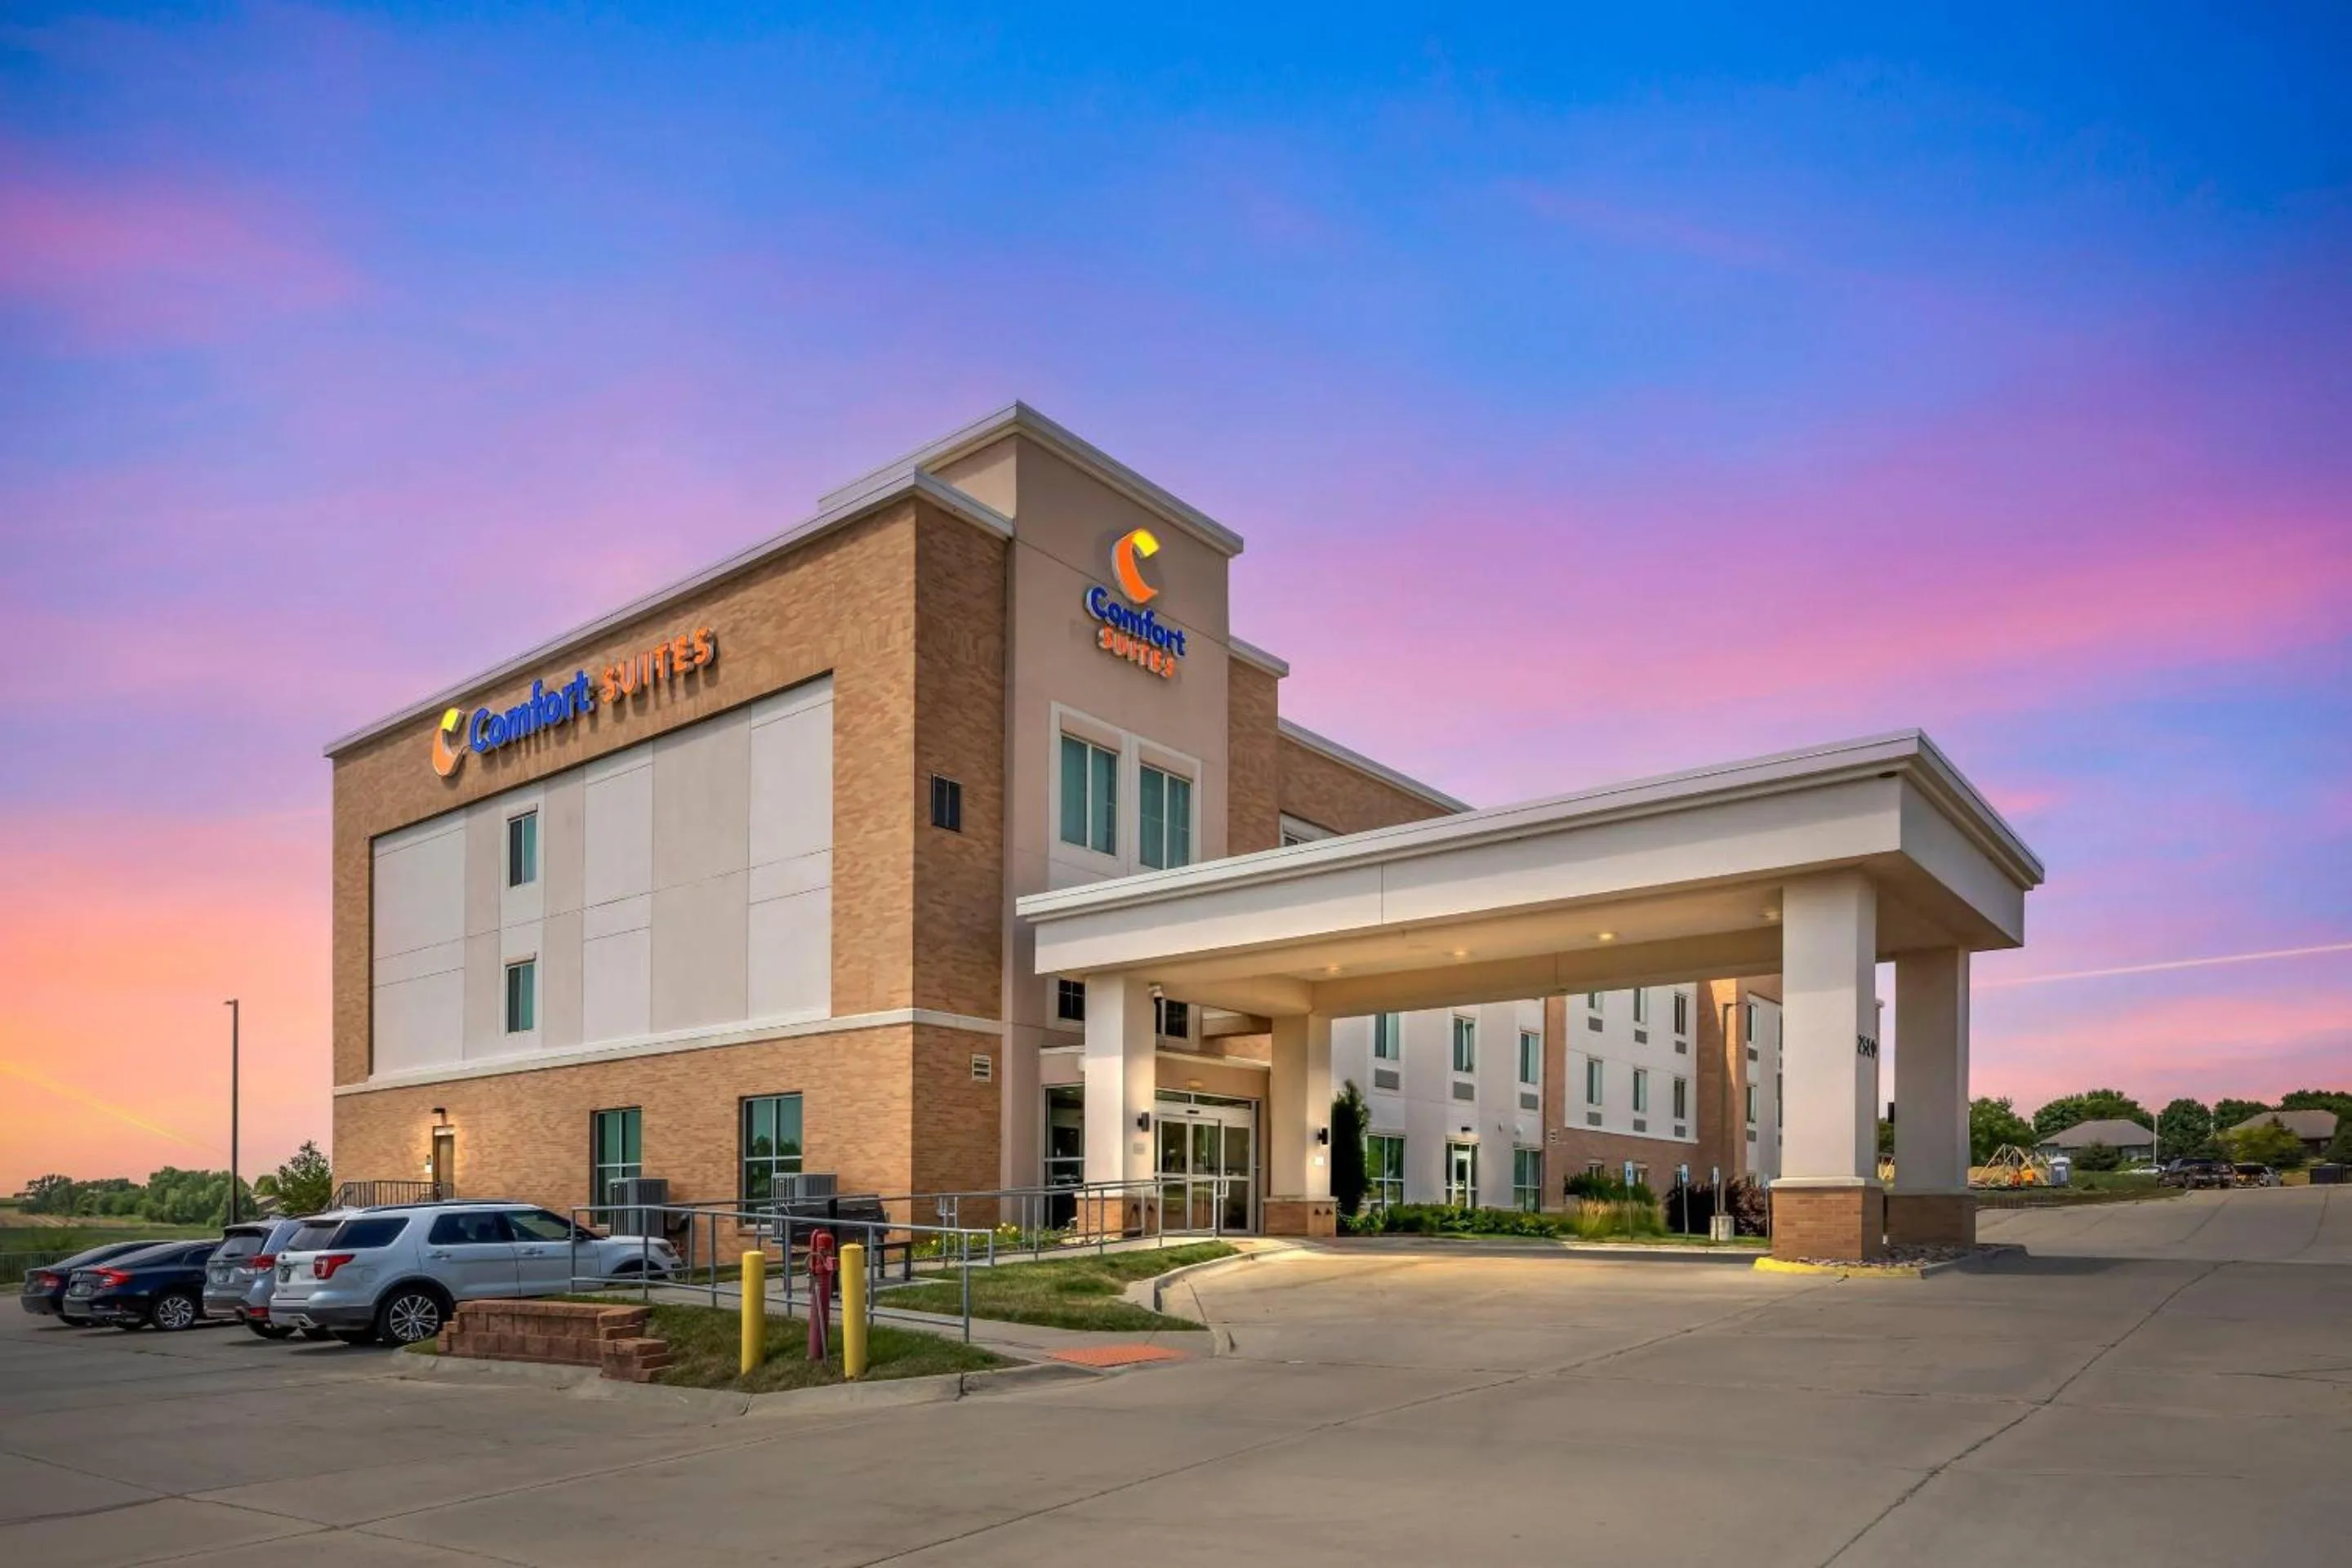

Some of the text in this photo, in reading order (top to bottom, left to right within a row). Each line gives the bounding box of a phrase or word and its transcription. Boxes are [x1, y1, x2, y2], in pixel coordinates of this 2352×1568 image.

[1087, 585, 1186, 659] Comfort
[1098, 626, 1175, 678] SUITES
[469, 669, 594, 754] Comfort
[601, 626, 716, 705] SUITES
